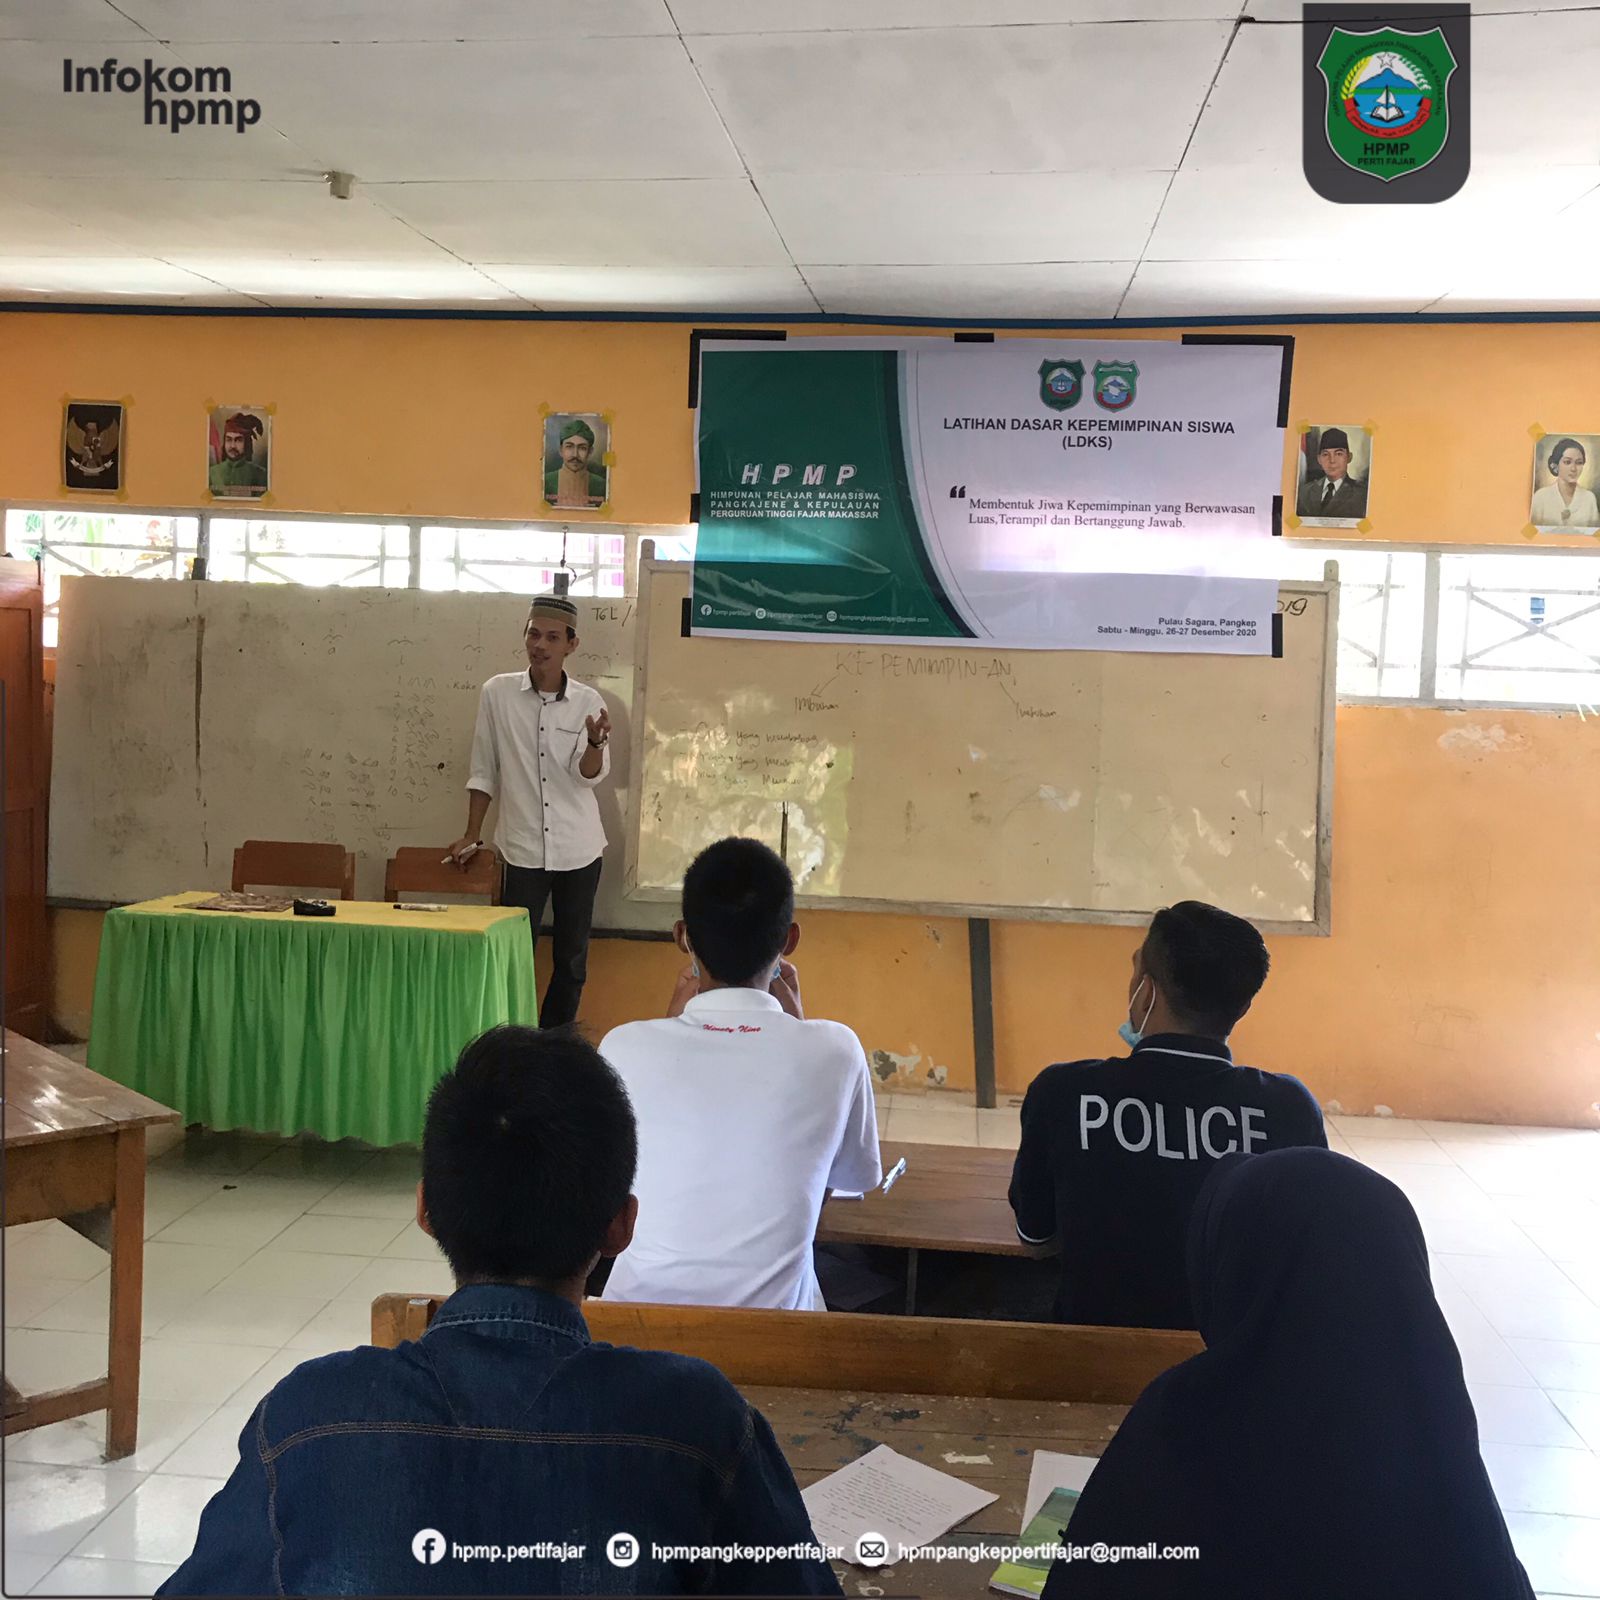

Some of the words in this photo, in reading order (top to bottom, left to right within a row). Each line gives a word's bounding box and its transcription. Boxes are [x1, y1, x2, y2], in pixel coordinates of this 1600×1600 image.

[943, 418, 1006, 430] LATIHAN
[1010, 418, 1063, 432] DASAR
[1068, 419, 1183, 433] KEPEMIMPINAN
[1187, 421, 1235, 434] SISWA
[1062, 436, 1113, 450] (LDKS)
[710, 491, 761, 499] HIMPUNAN
[767, 491, 813, 500] PELAJAR
[818, 492, 881, 500] MAHASISWA
[710, 500, 786, 509] PANGKAJENE
[794, 501, 800, 509] &
[807, 501, 880, 510] KEPULAUAN
[969, 498, 1034, 510] Membentuk
[1038, 500, 1064, 510] Jiwa
[1067, 500, 1152, 514] Kepemimpinan
[1154, 503, 1182, 515] yang
[1184, 502, 1256, 514] Berwawasan
[710, 510, 764, 518] PERGURUAN
[766, 510, 796, 518] TINGGI
[797, 510, 826, 518] FAJAR
[828, 510, 879, 519] MAKASSAR
[1050, 515, 1071, 526] dan
[1074, 515, 1145, 530] Bertanggung
[1148, 517, 1186, 528] Jawab.
[1158, 617, 1184, 626] Pulau
[1220, 618, 1257, 628] Pangkep
[1097, 626, 1122, 634] Sabtu
[1166, 627, 1189, 636] 26-27
[1191, 628, 1234, 636] Desember
[1236, 628, 1257, 637] 2020
[1080, 1094, 1268, 1160] POLICE
